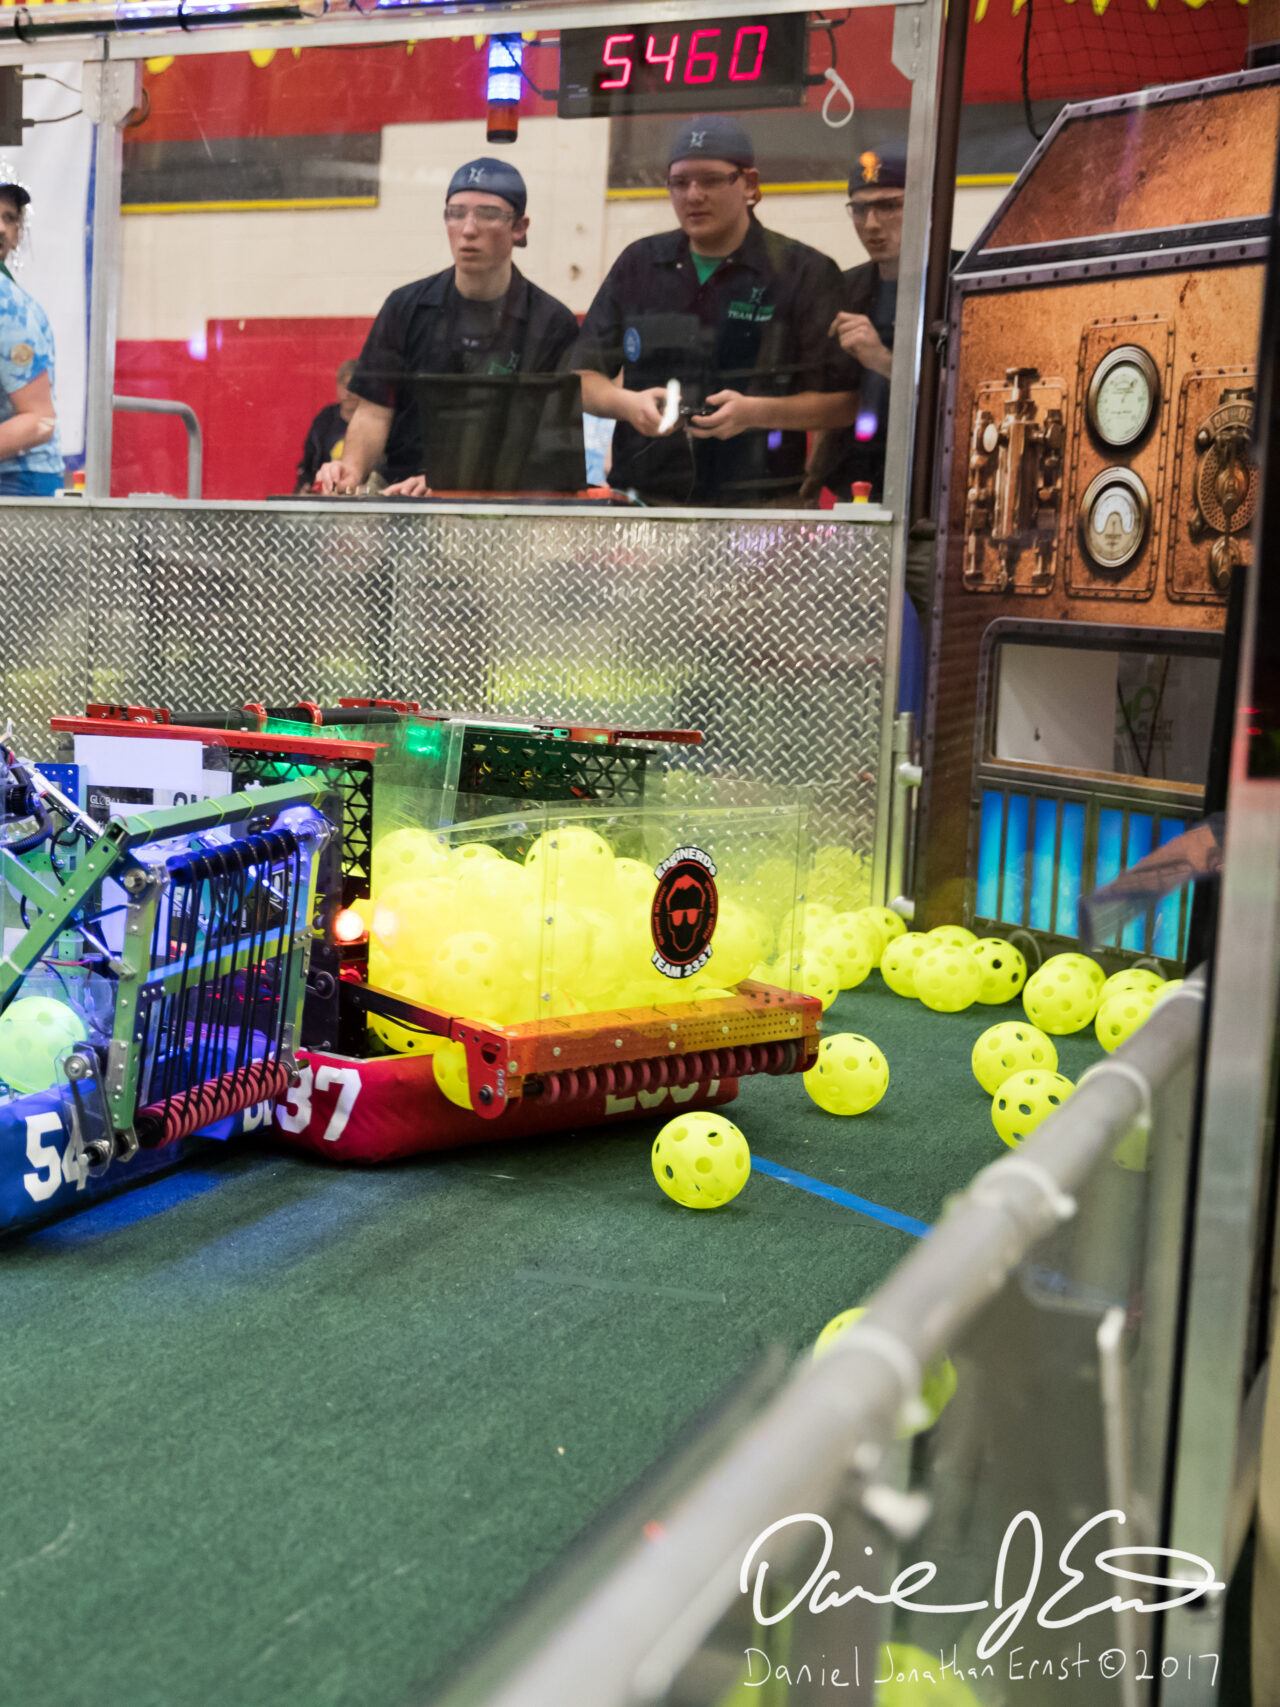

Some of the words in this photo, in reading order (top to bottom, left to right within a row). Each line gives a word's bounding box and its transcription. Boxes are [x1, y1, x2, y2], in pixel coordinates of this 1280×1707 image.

[600, 25, 768, 88] 5460
[651, 950, 681, 978] TEAM
[683, 943, 713, 977] 2337
[275, 1064, 363, 1142] 37
